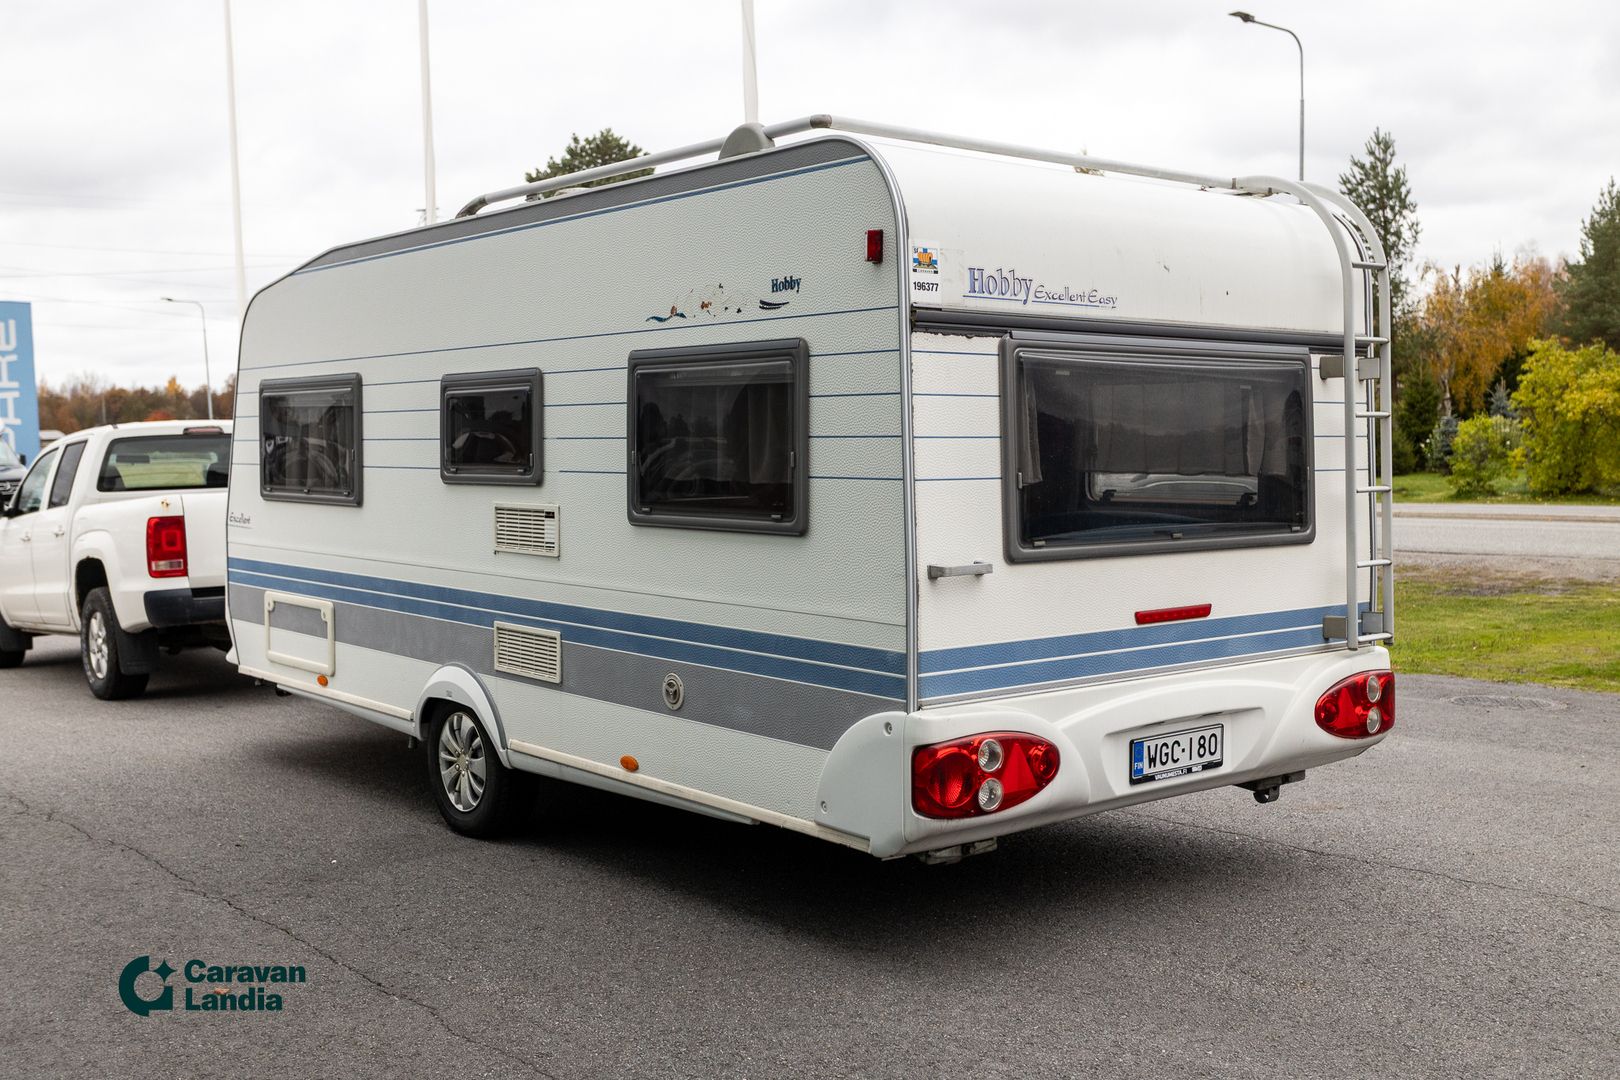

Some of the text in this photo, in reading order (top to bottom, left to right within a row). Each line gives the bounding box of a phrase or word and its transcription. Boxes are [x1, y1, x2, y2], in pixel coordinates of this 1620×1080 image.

[771, 275, 801, 293] Hobby
[913, 281, 939, 292] 196377
[968, 267, 1118, 306] Hobby Excellent Easy
[1147, 733, 1218, 769] WGC-180
[1134, 762, 1144, 770] FIN
